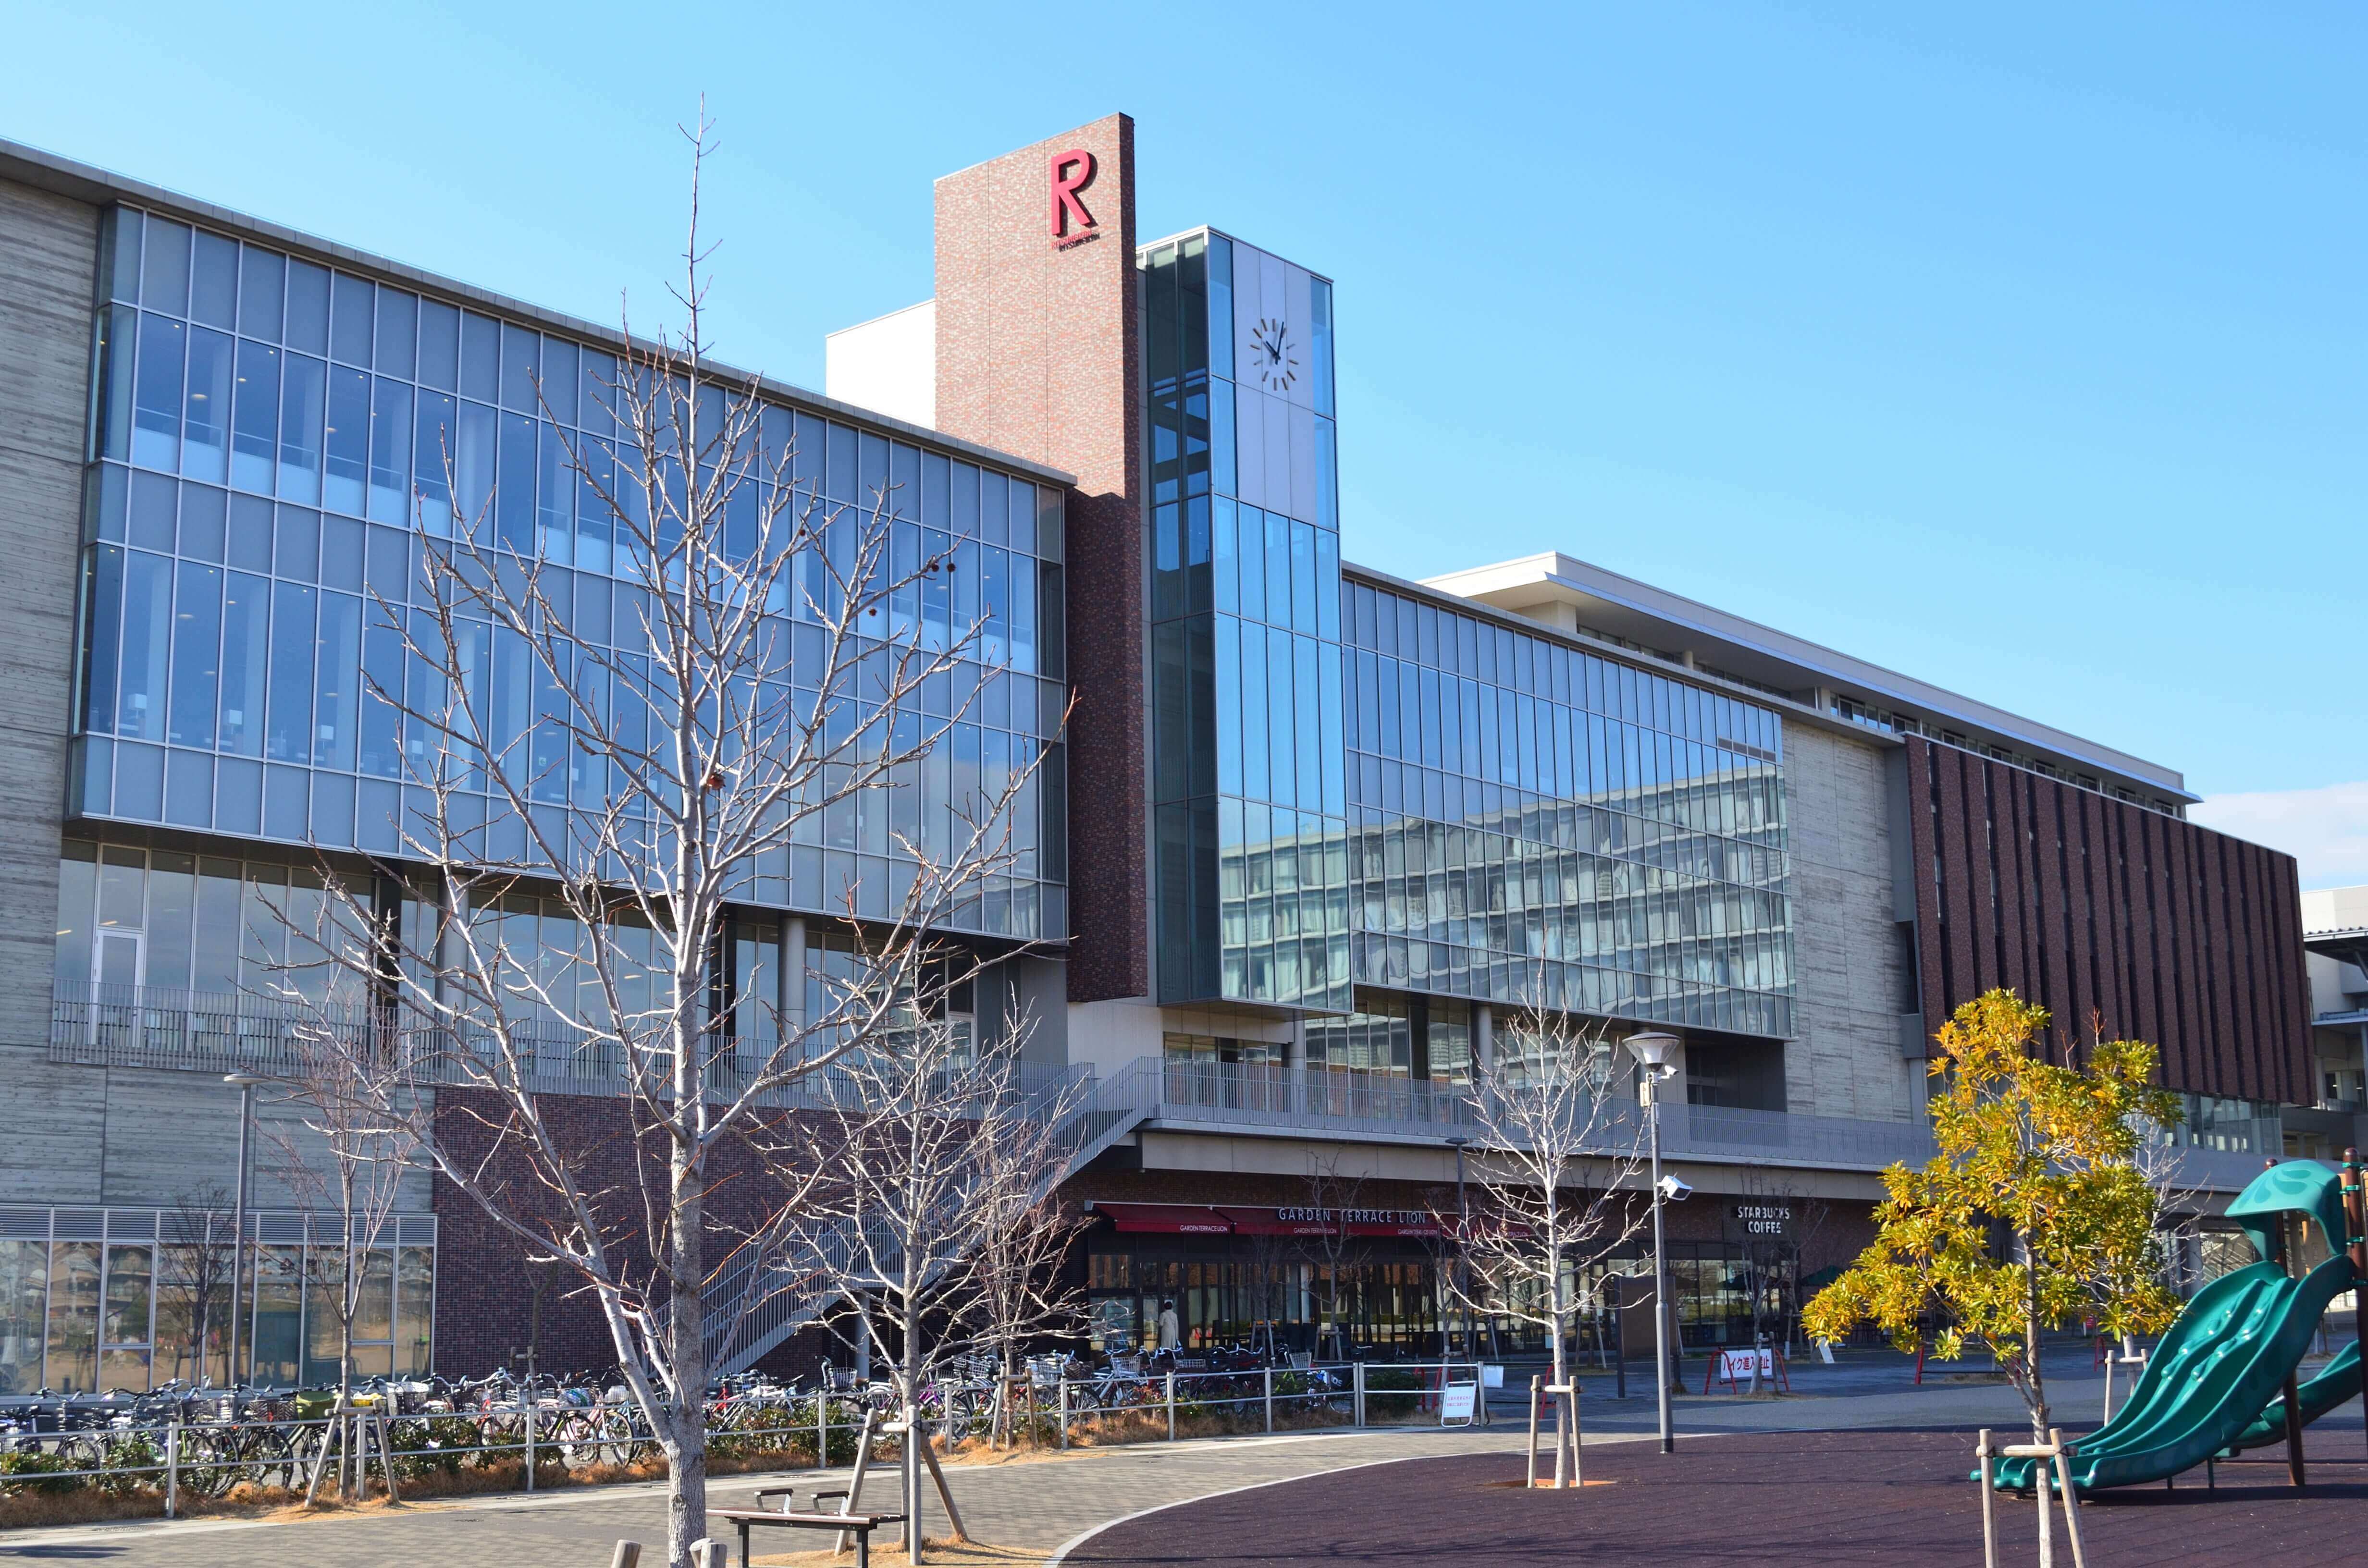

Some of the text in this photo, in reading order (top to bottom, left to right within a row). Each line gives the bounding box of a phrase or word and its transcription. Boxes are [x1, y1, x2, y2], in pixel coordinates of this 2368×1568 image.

[1051, 149, 1090, 235] R
[1279, 1208, 1425, 1224] GARDEN TERRACE LION
[1738, 1206, 1789, 1219] STARBUCKS
[1748, 1221, 1781, 1233] COFFEE
